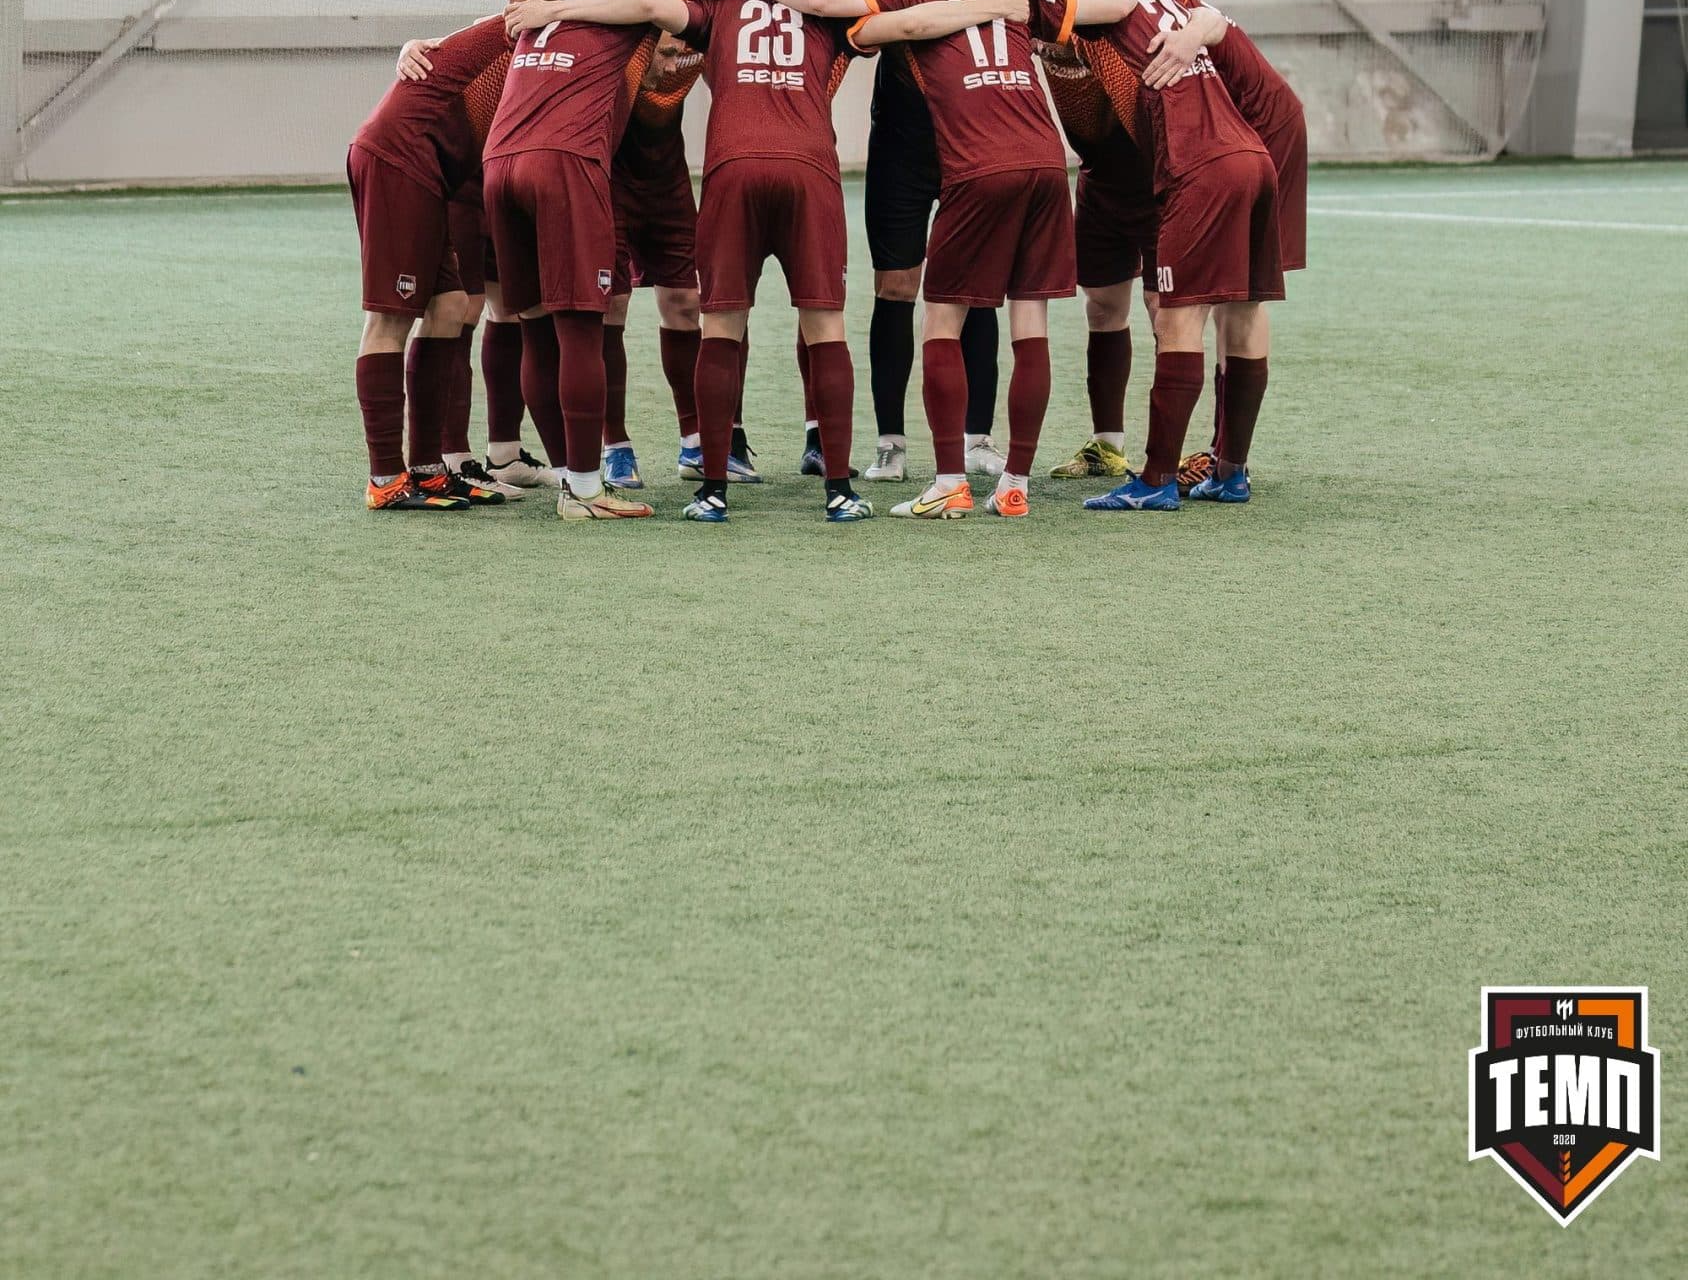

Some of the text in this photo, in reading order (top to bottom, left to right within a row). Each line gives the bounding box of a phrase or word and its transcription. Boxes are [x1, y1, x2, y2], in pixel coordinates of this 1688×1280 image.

[737, 0, 805, 66] 23
[512, 51, 575, 69] SEUS
[737, 69, 804, 86] SEUS
[962, 70, 1031, 89] SEUS
[1157, 266, 1174, 292] 20
